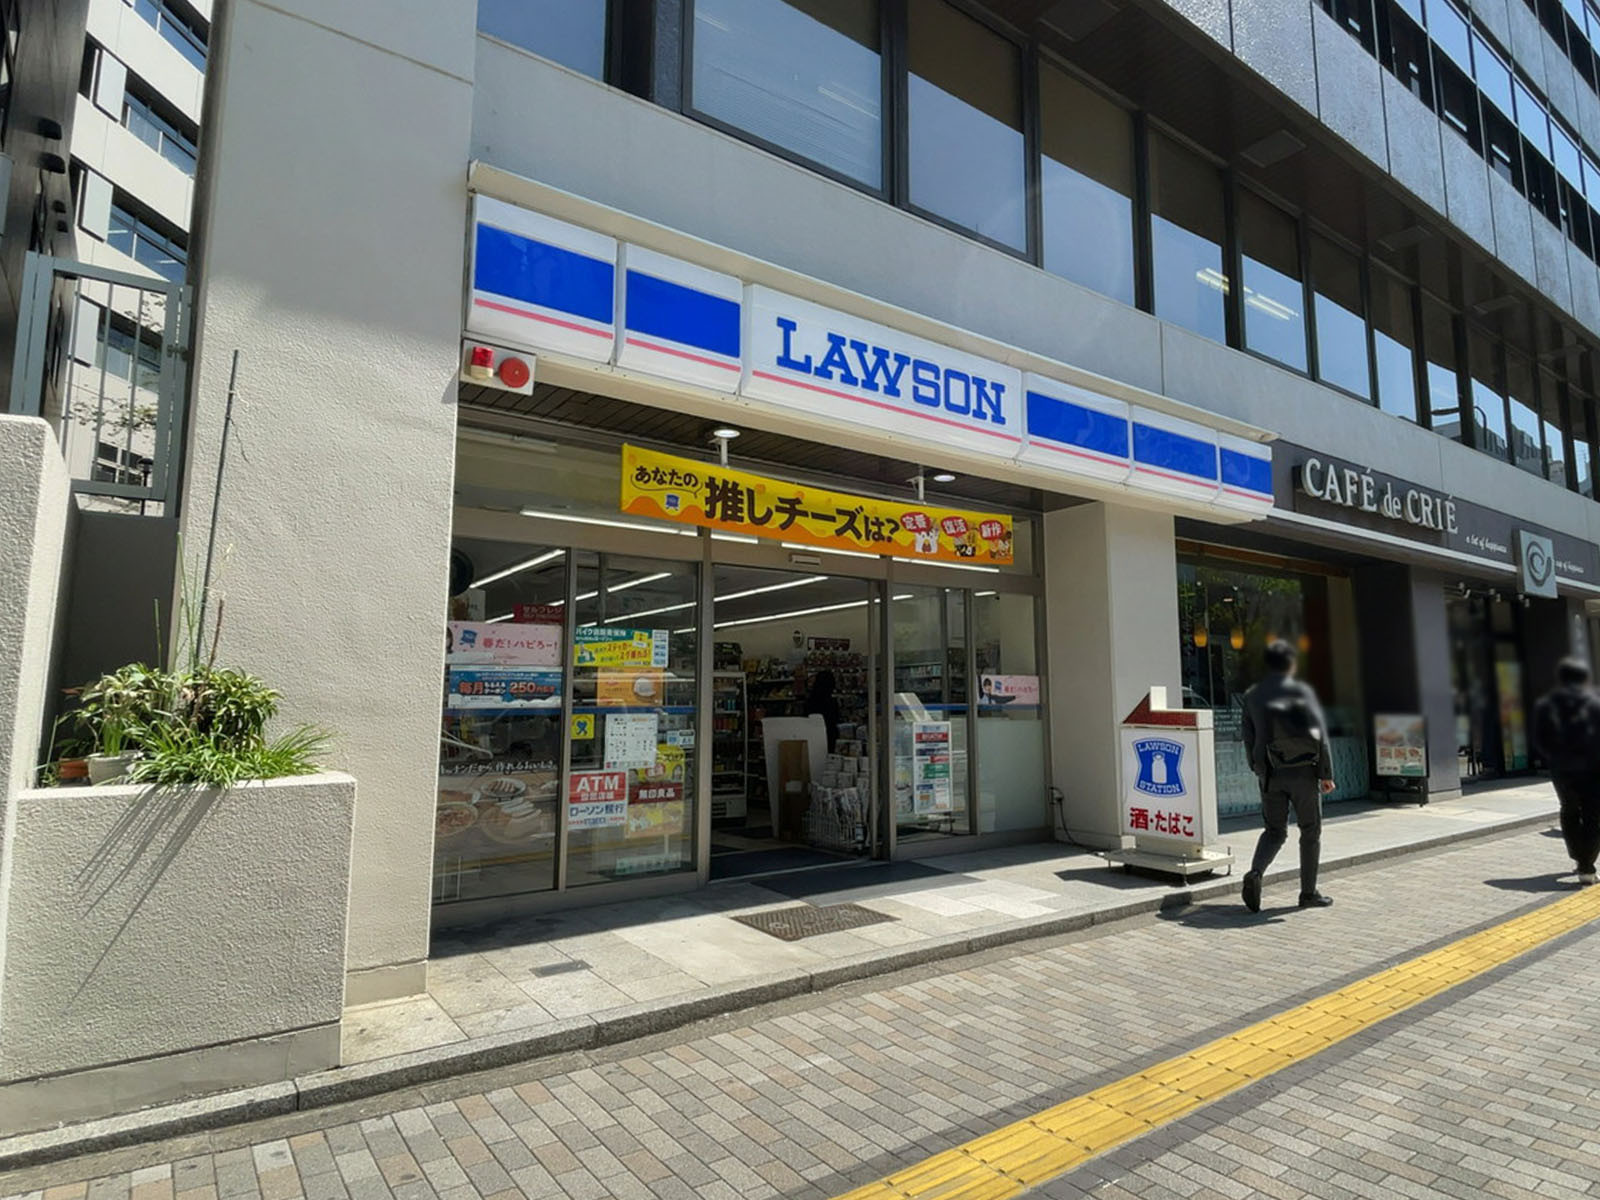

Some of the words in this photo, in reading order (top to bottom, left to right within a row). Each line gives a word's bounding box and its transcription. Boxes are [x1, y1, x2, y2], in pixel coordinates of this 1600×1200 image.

[777, 317, 1006, 425] LAWSON
[635, 465, 698, 488] あなたの
[1303, 458, 1377, 512] CAFÉ
[1383, 482, 1402, 518] de
[1406, 489, 1458, 534] CRIÉ
[705, 476, 900, 543] 推しチーズは?
[902, 514, 929, 530] 定番
[943, 518, 967, 534] 復活
[981, 523, 1003, 538] 新作
[1138, 742, 1180, 755] LAWSON
[576, 775, 619, 792] ATM
[1140, 780, 1181, 794] STATION
[570, 804, 624, 817] ローソン銀行
[1130, 807, 1194, 837] 酒・たばこ
